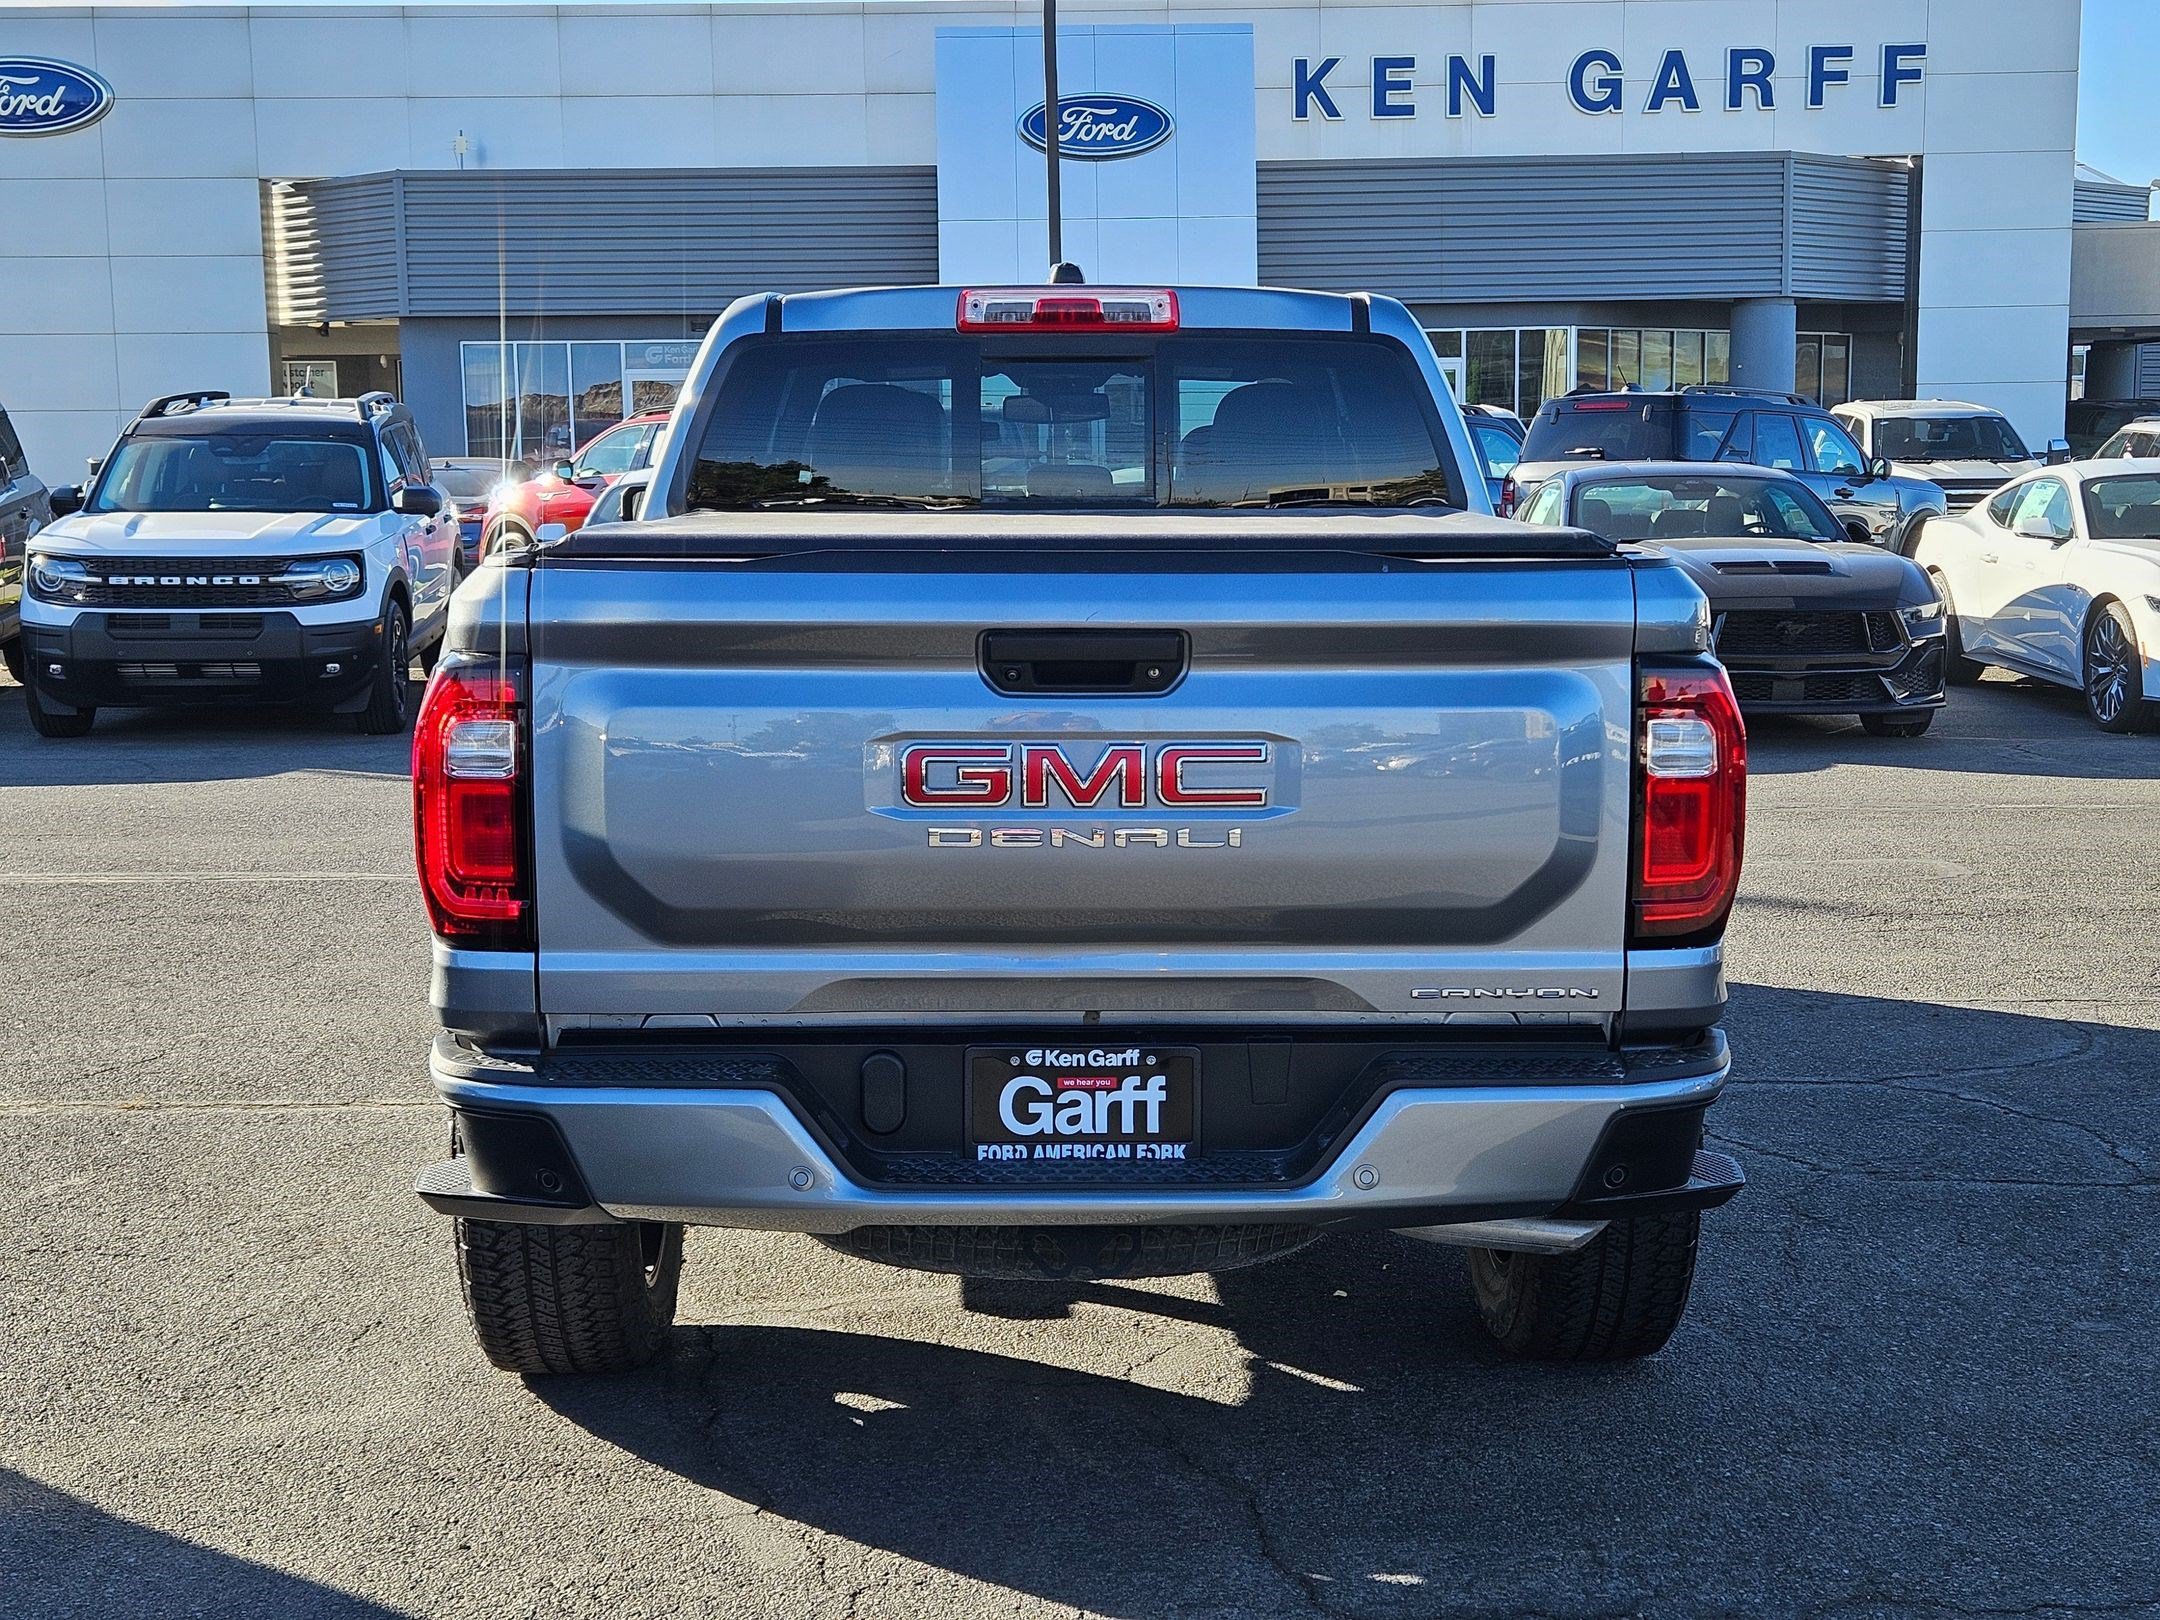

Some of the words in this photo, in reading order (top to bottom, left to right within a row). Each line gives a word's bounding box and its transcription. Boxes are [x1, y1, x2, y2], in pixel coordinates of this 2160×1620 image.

[1292, 54, 1498, 120] KEN
[1566, 43, 1928, 115] GARFF
[1058, 107, 1139, 142] Ford
[664, 345, 680, 354] Ken
[664, 353, 692, 364] Ford
[108, 576, 260, 585] BRONCO
[901, 742, 1269, 808] GMC
[927, 827, 1242, 848] DENALI
[1411, 988, 1599, 999] CANYON
[1045, 1049, 1085, 1067] Ken
[1087, 1049, 1140, 1067] Garff
[1095, 1080, 1111, 1088] you
[999, 1075, 1167, 1136] Garff
[977, 1144, 1028, 1160] FORD
[1033, 1144, 1131, 1160] AMERICAN
[1136, 1144, 1187, 1160] FORK
